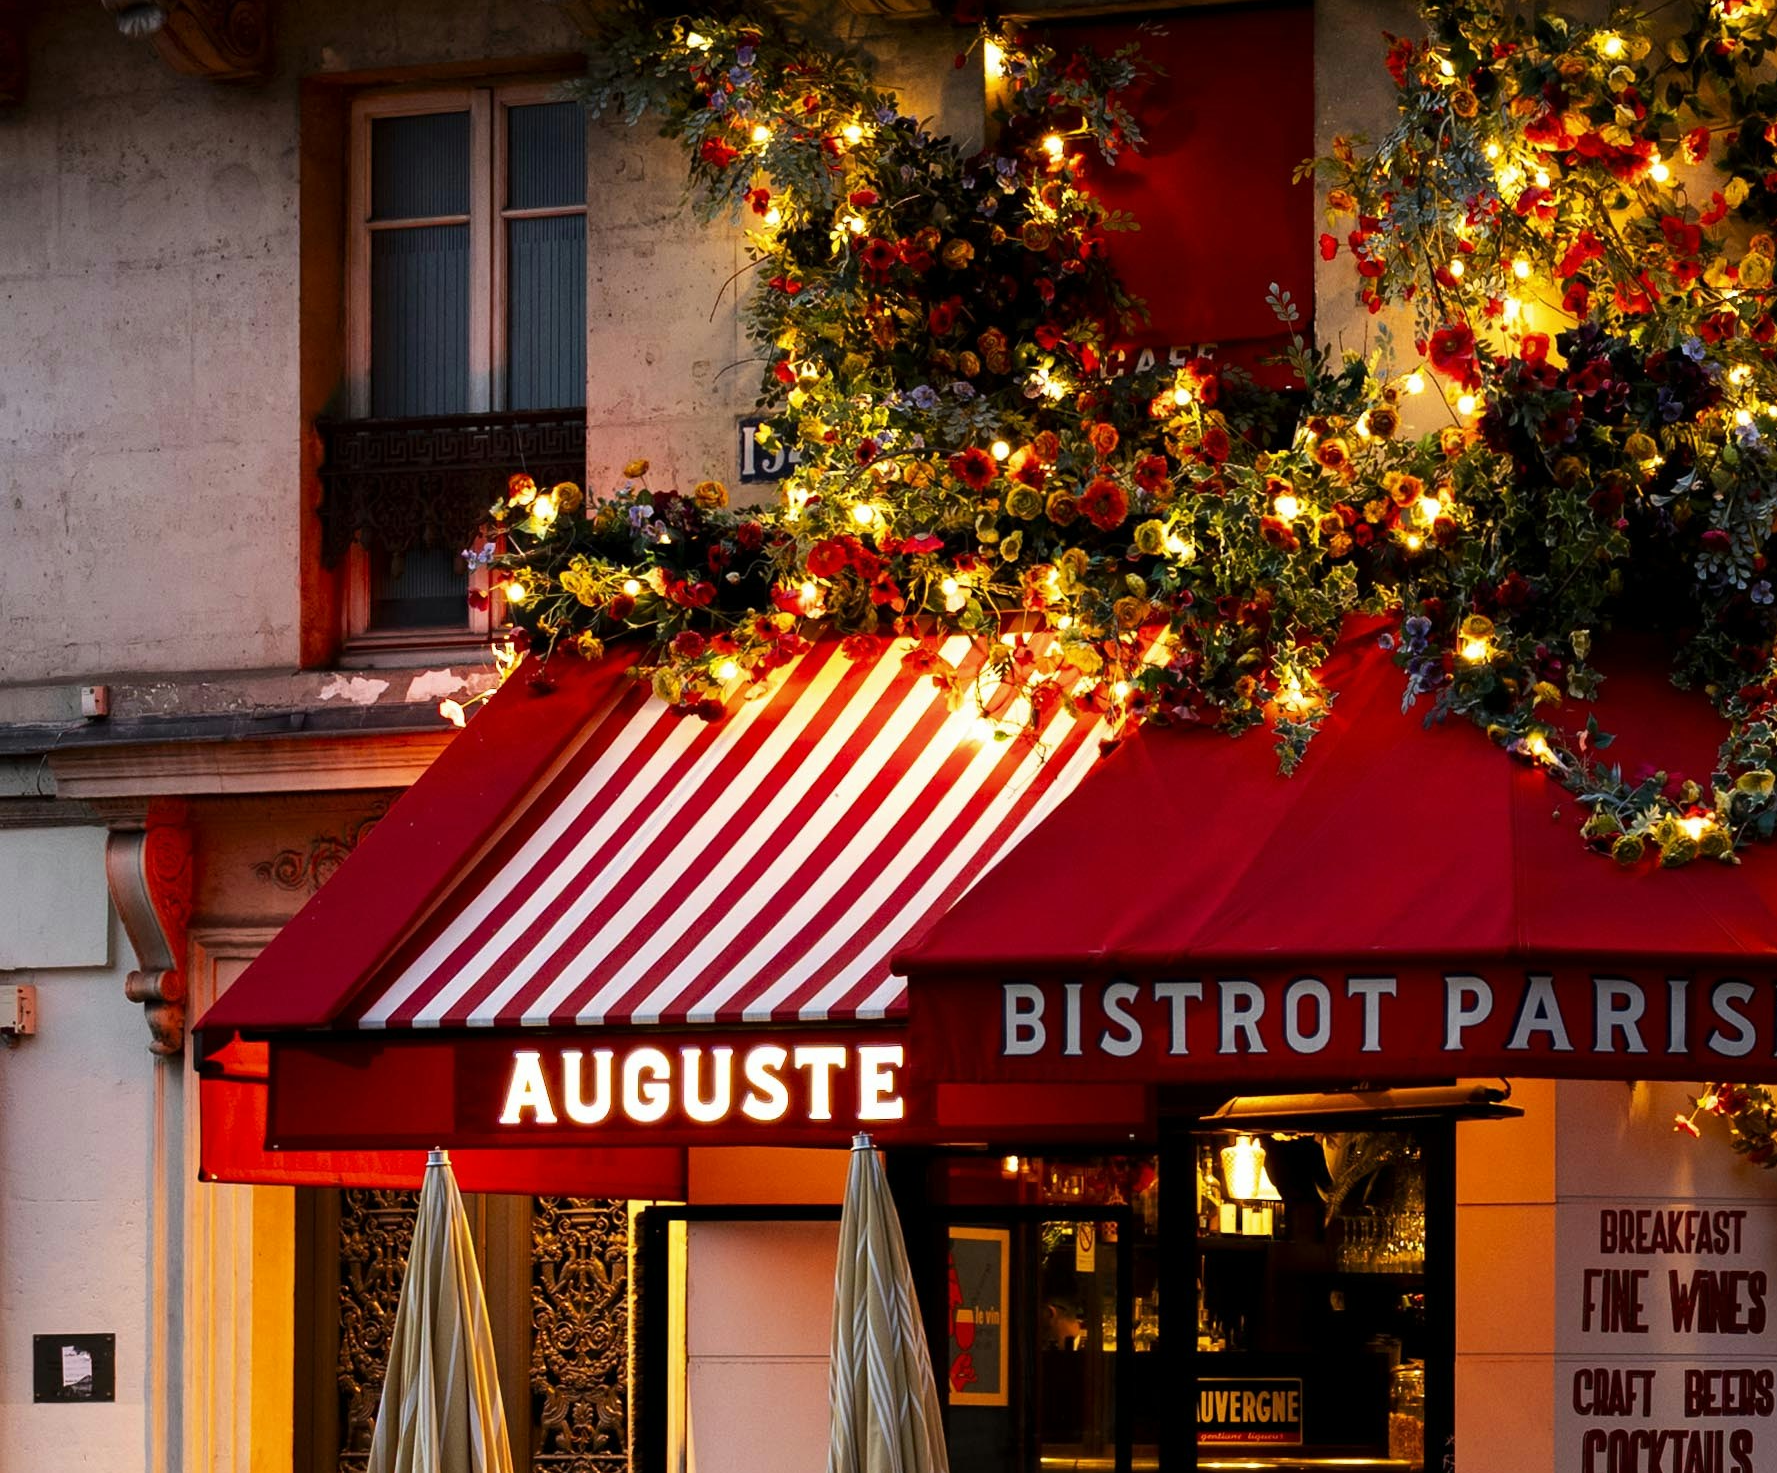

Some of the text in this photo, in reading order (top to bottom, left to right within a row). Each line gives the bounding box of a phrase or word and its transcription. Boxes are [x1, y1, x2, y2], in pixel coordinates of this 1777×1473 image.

[1002, 977, 1397, 1056] BISTROT
[498, 1043, 905, 1124] AUGUSTE
[1600, 1209, 1747, 1255] BREAKFAST
[1582, 1268, 1649, 1333] FINE
[1572, 1368, 1775, 1417] CRAFT BEERS
